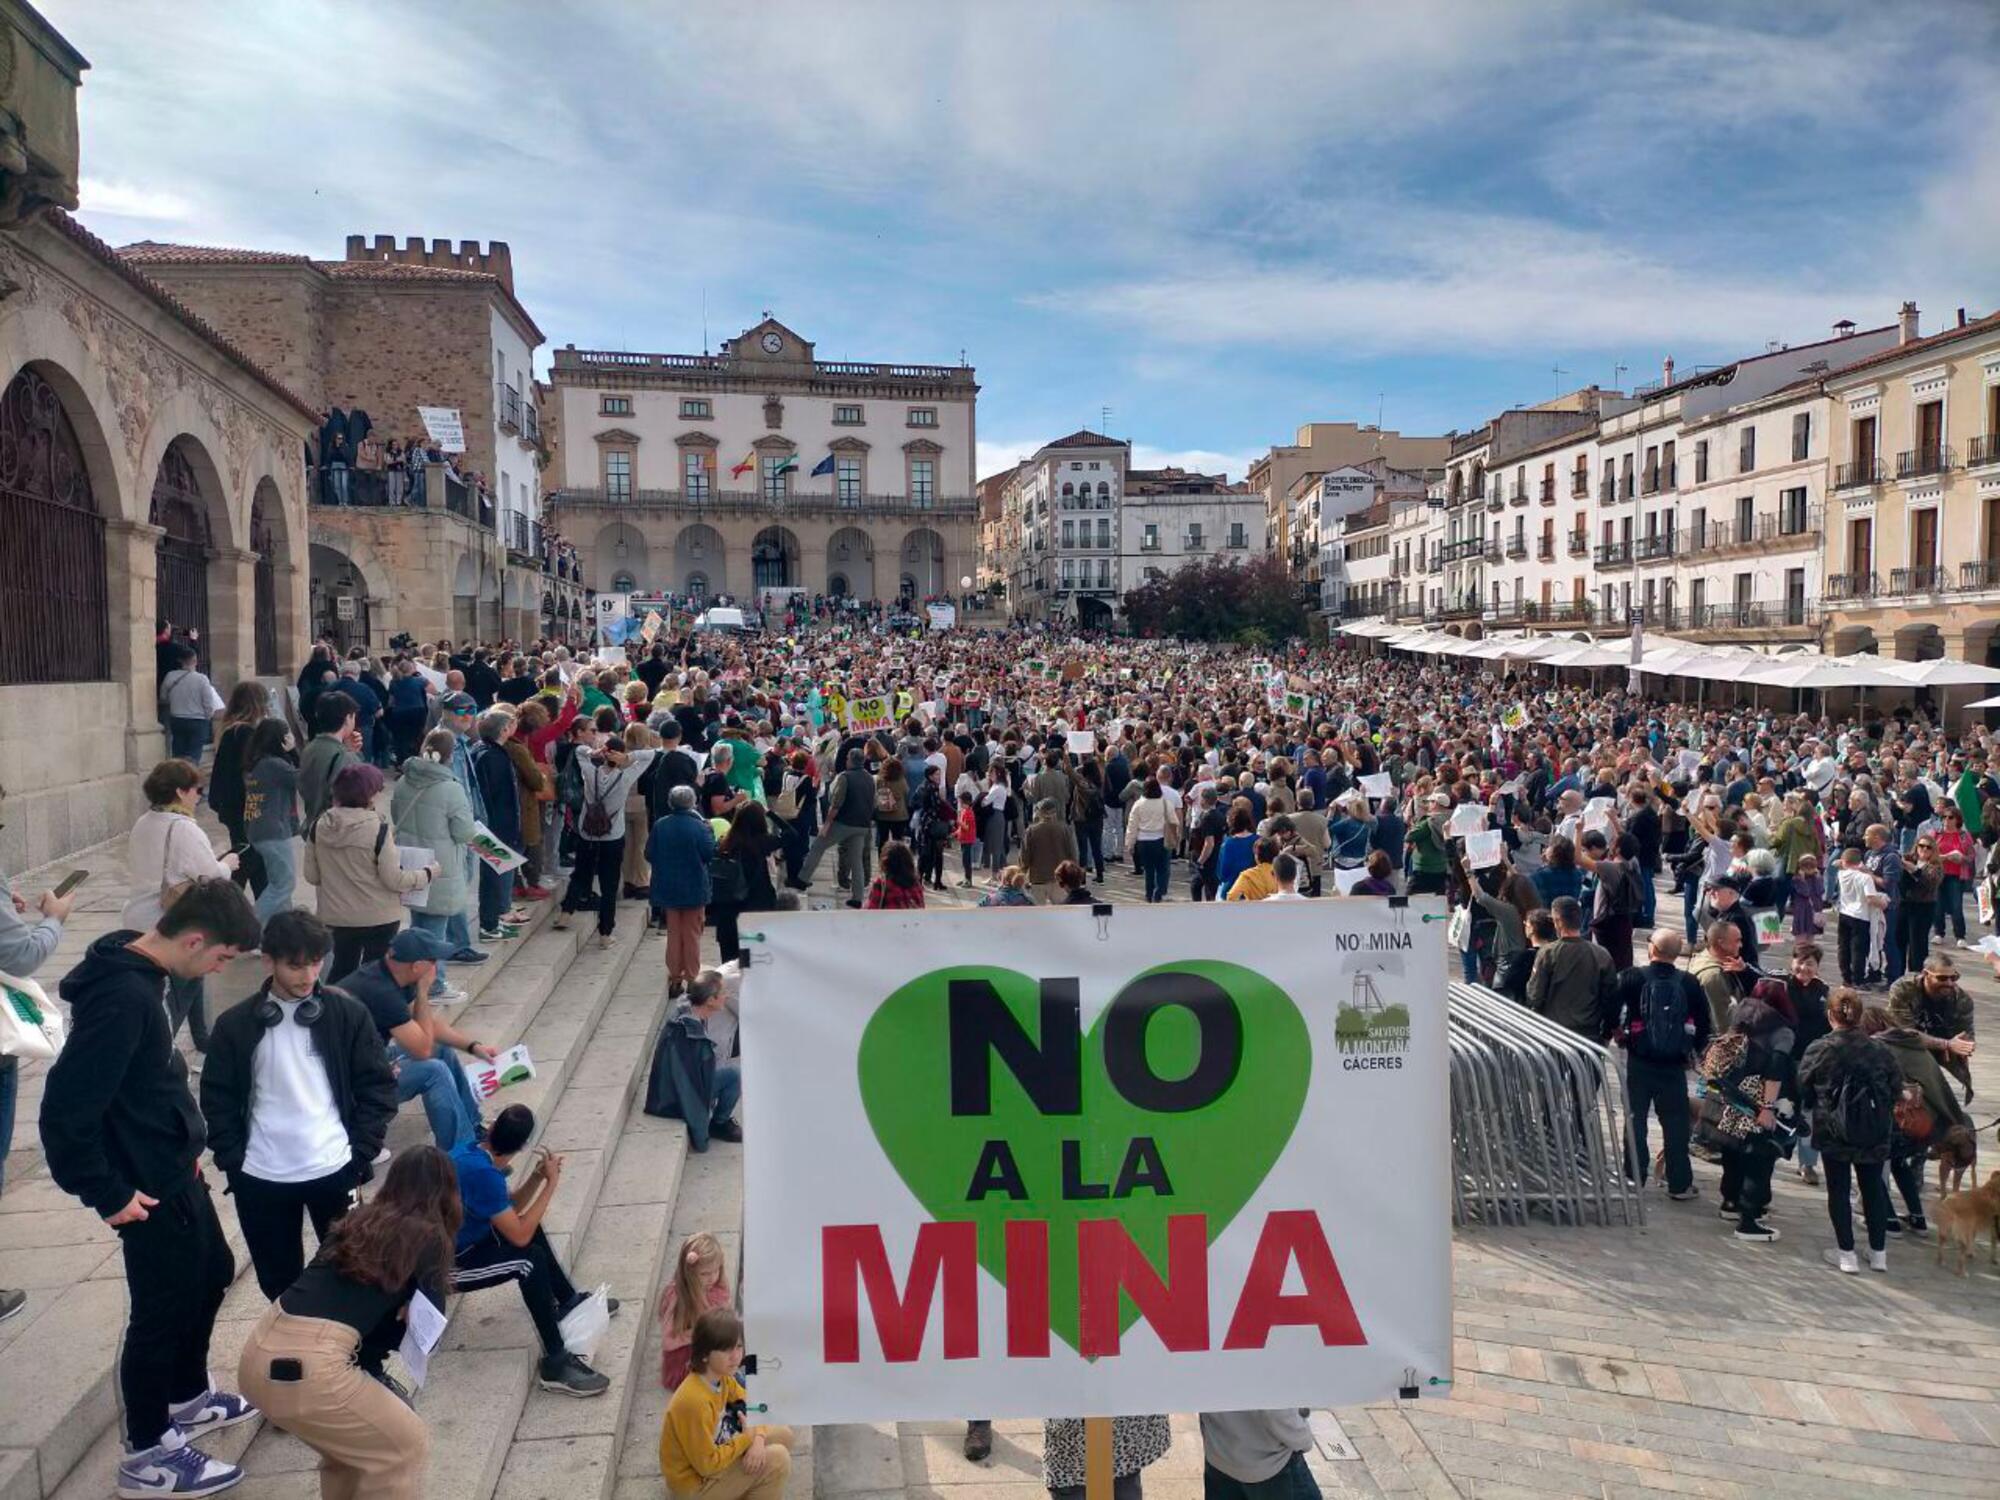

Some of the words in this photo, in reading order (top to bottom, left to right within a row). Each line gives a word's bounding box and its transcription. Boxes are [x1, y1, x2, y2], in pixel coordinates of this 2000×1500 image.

[858, 699, 879, 712] NO
[851, 716, 891, 731] MINA
[1335, 933, 1360, 951] NO
[1369, 932, 1412, 950] MINA
[948, 972, 1243, 1116] NO
[1343, 1055, 1403, 1070] CÁCERES
[965, 1140, 1029, 1201] A
[1061, 1137, 1174, 1200] LA
[822, 1209, 1368, 1363] MINA
